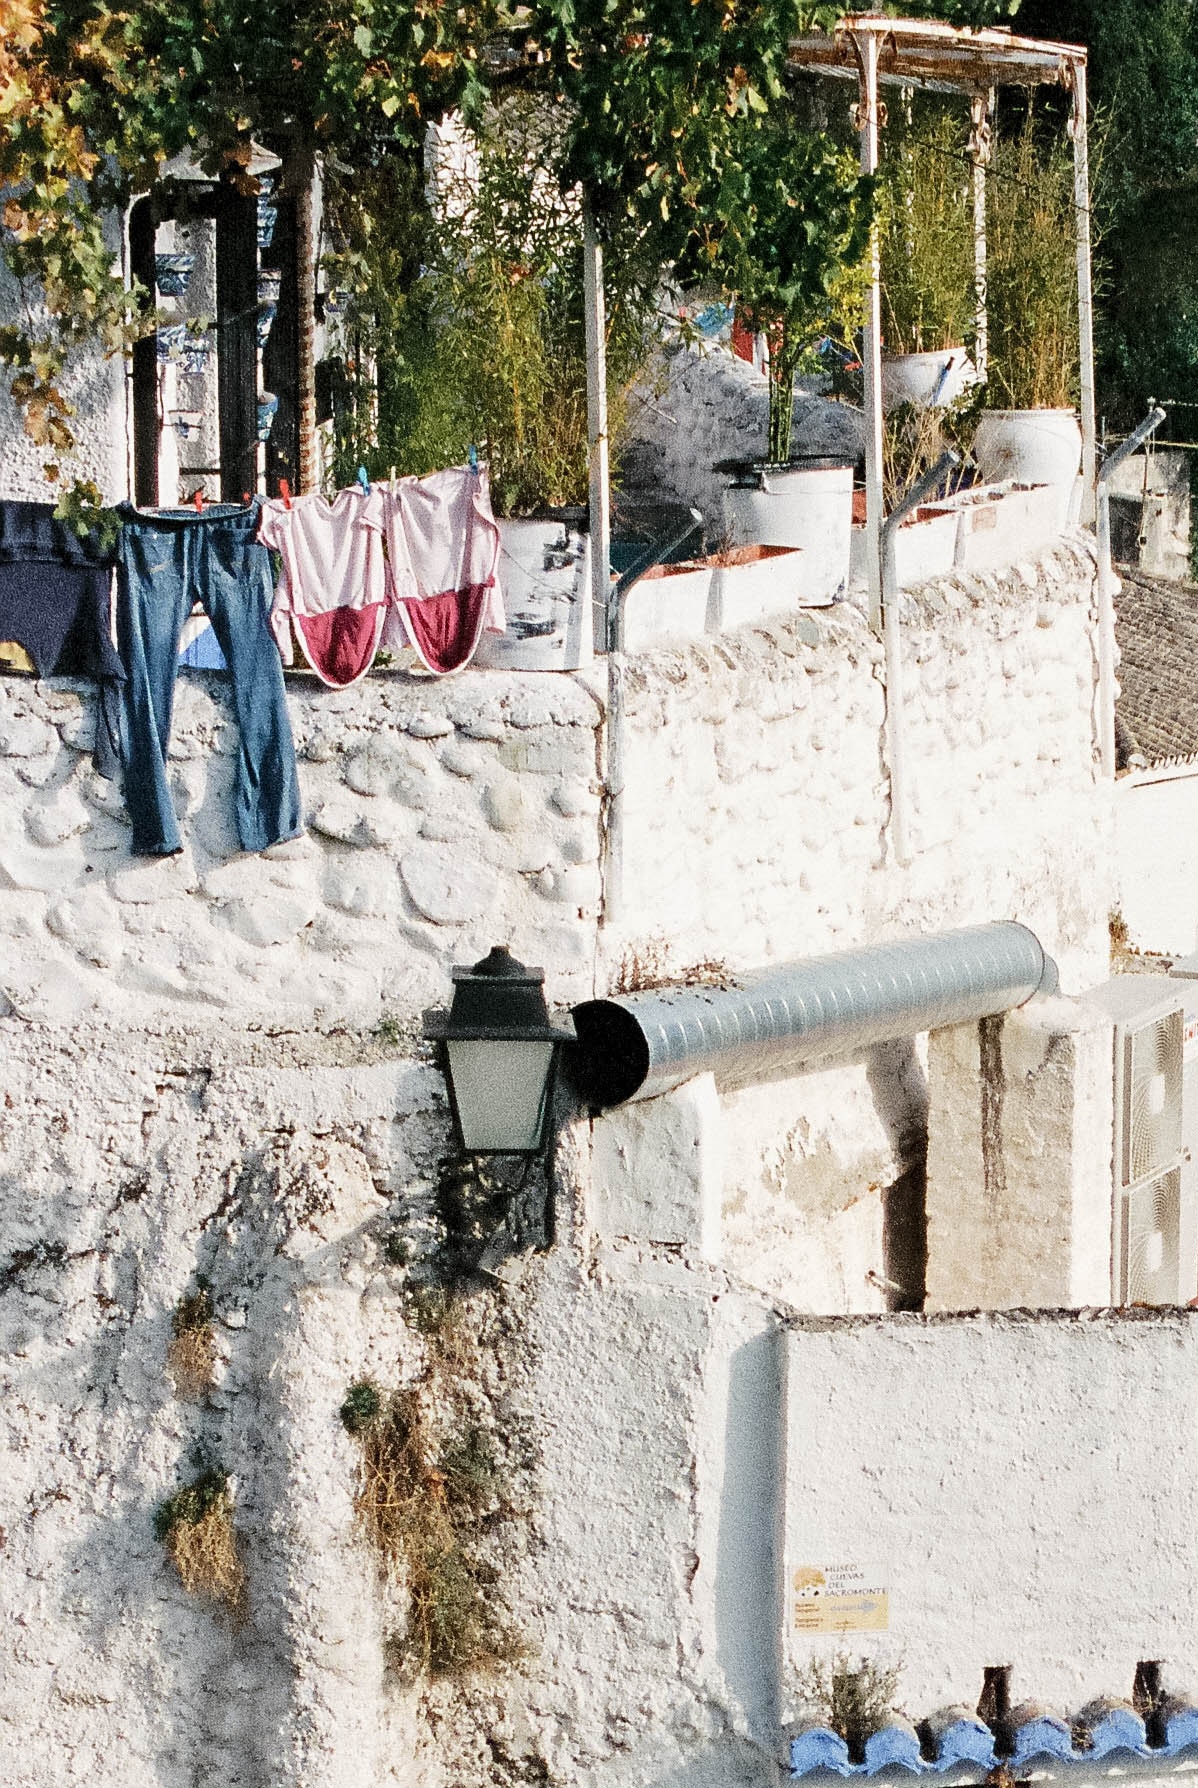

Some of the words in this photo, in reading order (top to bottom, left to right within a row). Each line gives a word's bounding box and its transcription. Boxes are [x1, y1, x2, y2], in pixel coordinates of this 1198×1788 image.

[825, 1564, 858, 1573] MUSEO
[828, 1581, 845, 1589] DEL
[824, 1587, 888, 1597] SACROMONTE
